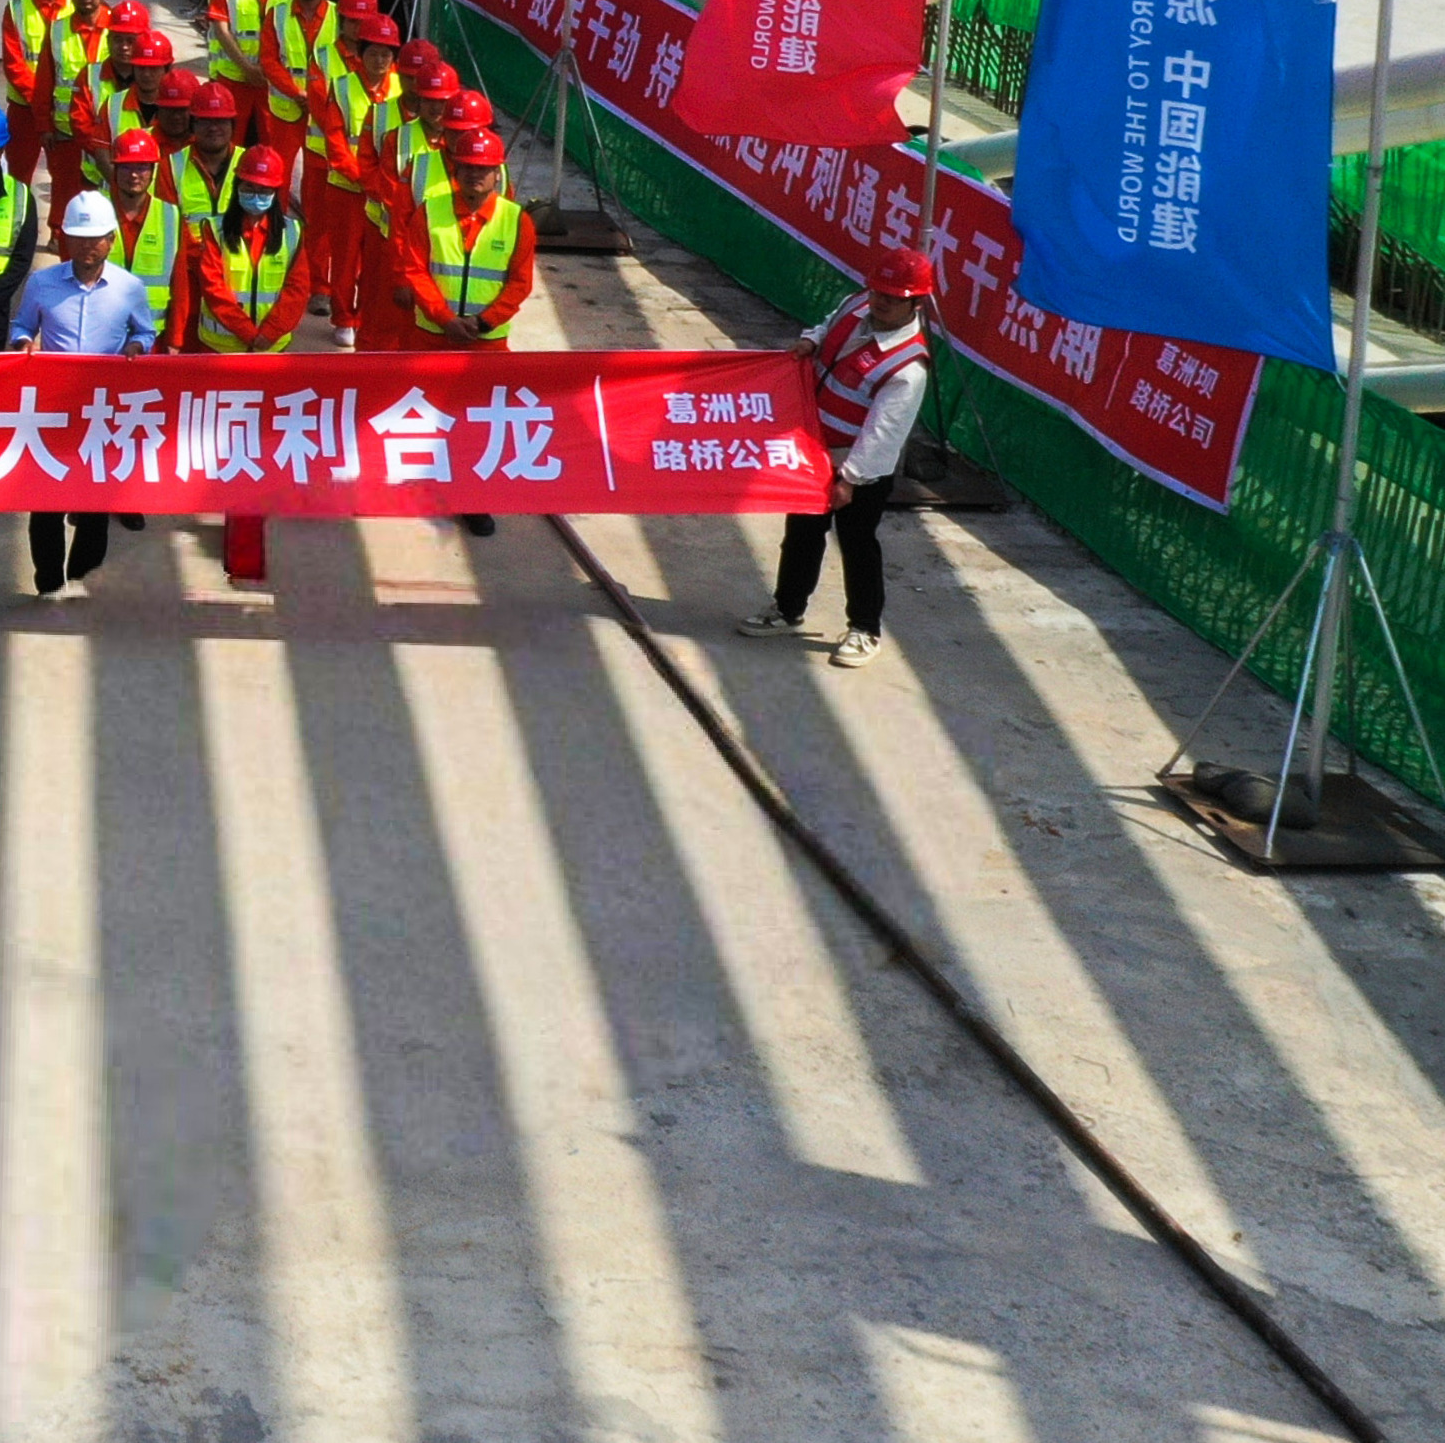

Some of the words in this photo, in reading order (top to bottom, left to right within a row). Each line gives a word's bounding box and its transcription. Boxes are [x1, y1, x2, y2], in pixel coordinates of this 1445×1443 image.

[1155, 341, 1220, 399] 葛洲坝
[662, 392, 775, 424] 葛洲坝
[1129, 378, 1216, 449] 路桥公司
[651, 437, 801, 471] 路桥公司
